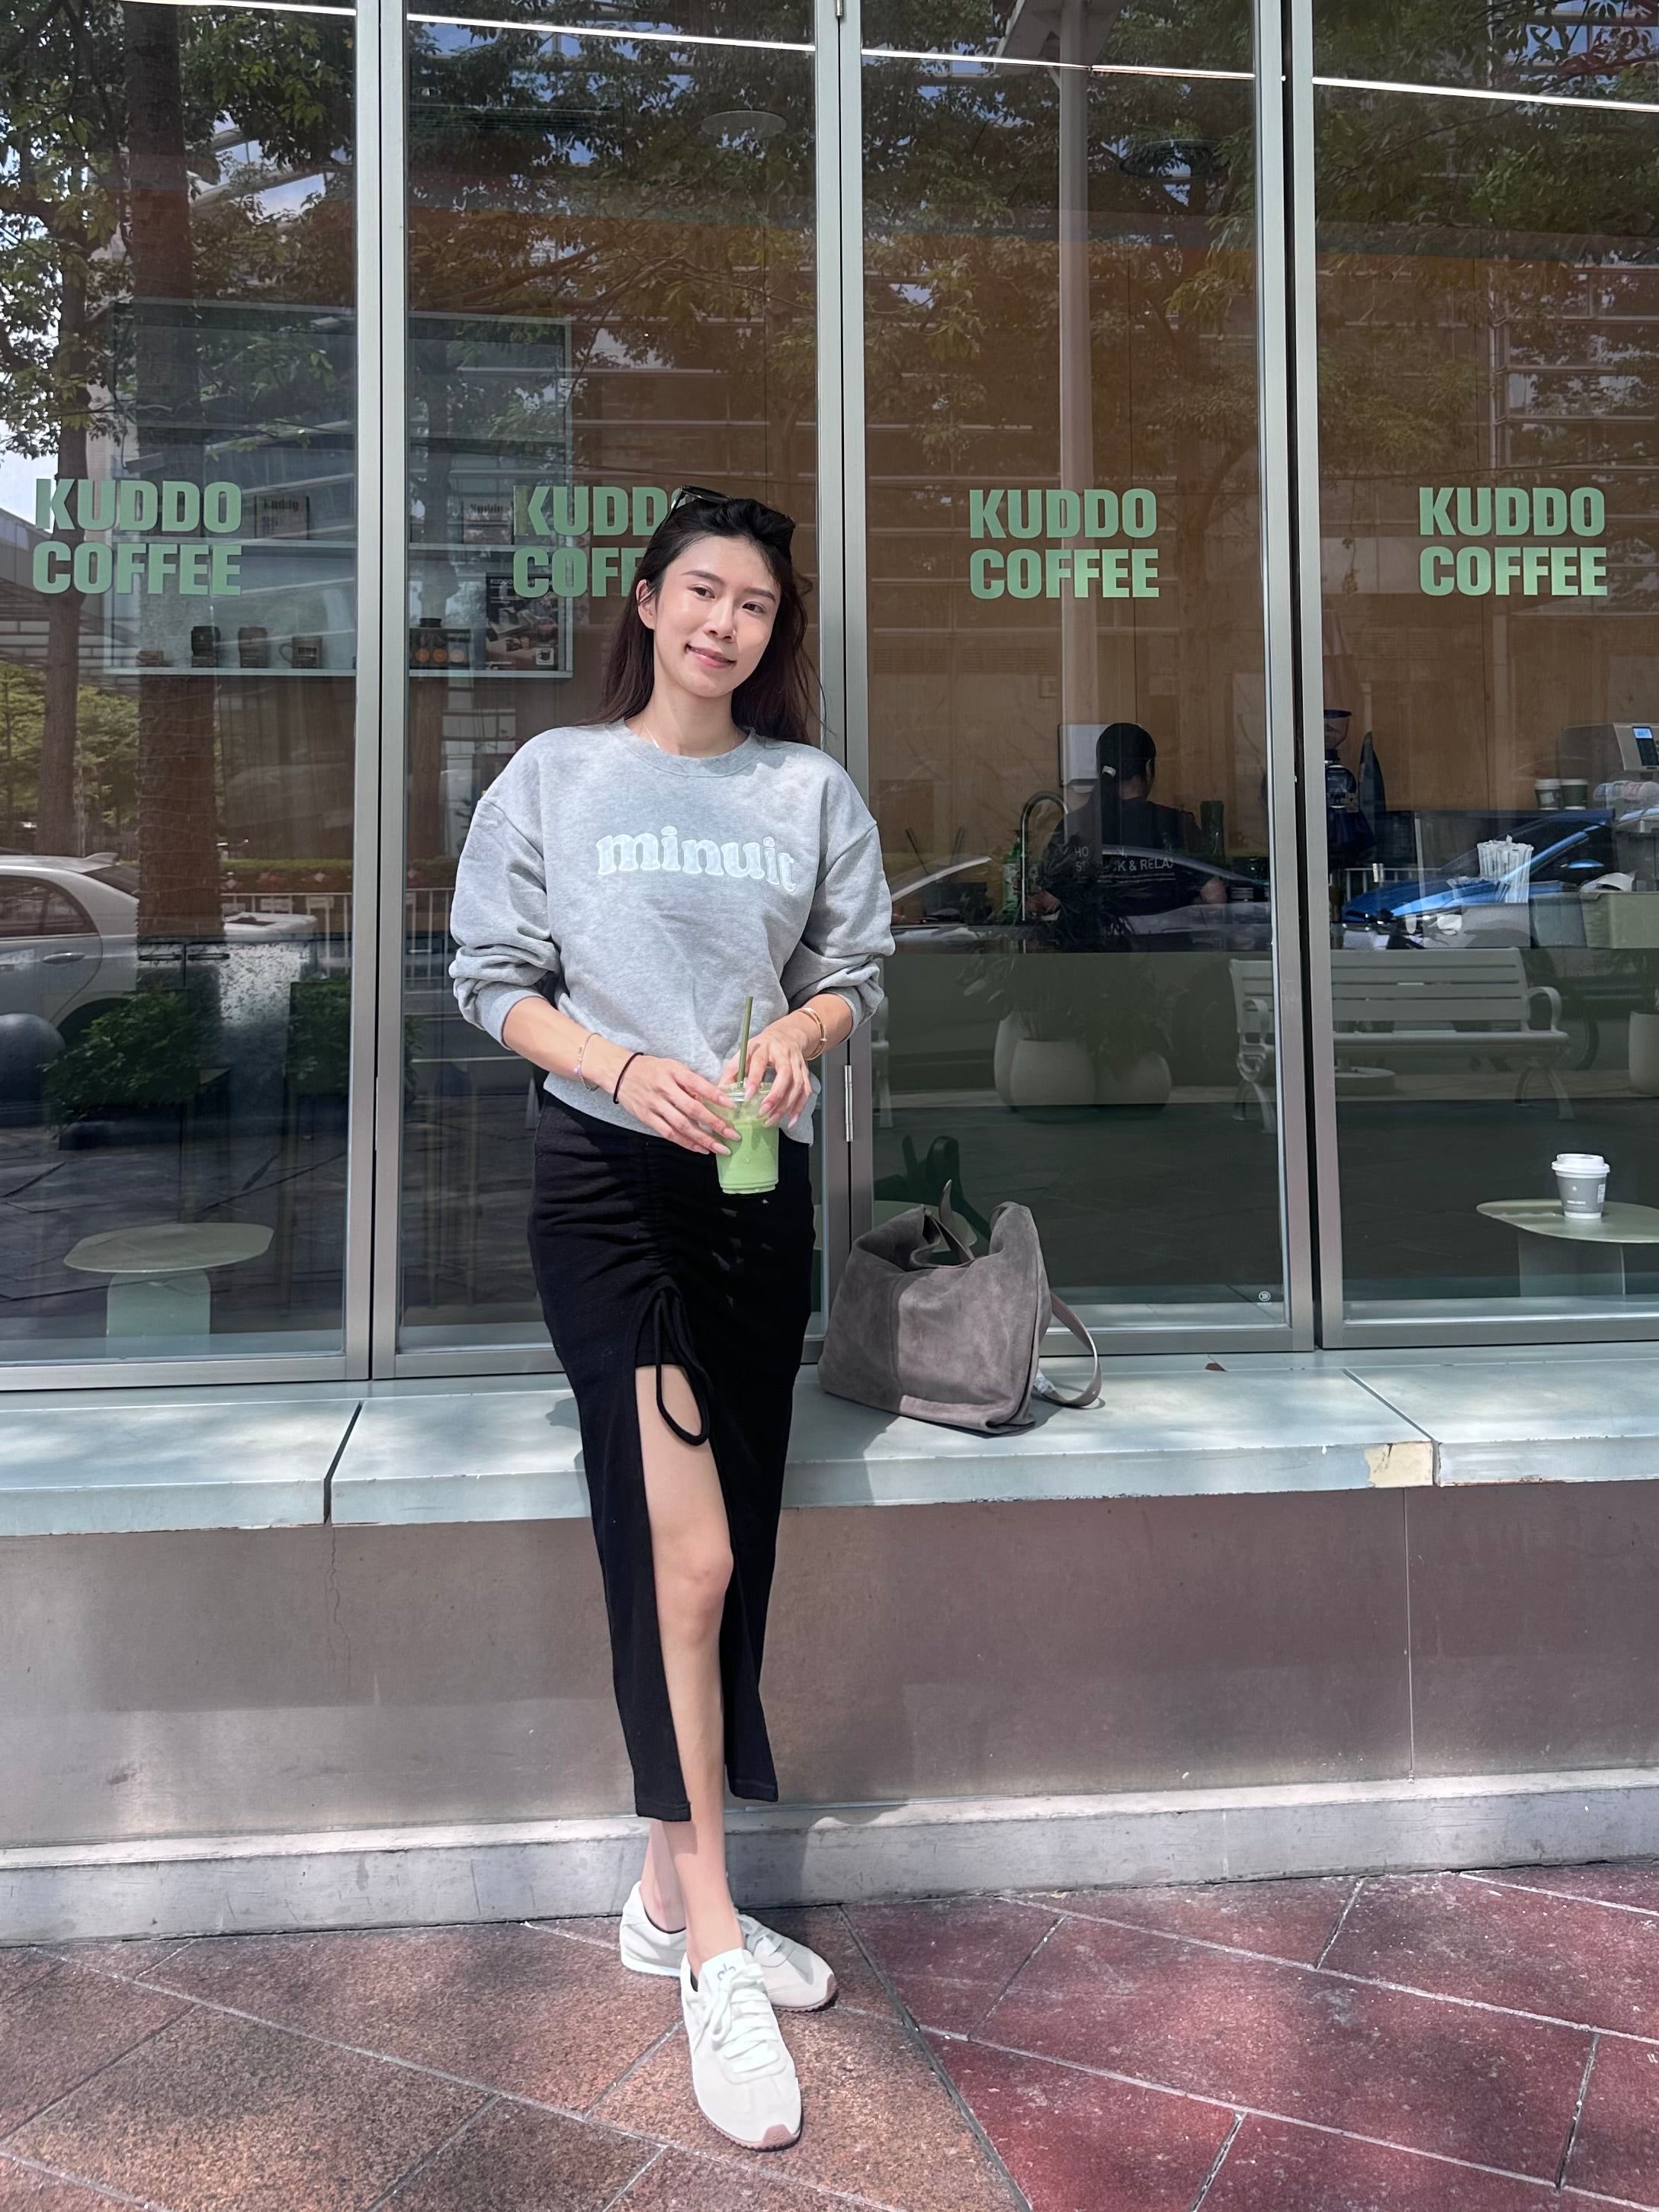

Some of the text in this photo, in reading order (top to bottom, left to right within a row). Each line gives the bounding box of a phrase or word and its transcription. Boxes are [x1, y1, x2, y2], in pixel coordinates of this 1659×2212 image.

[35, 478, 242, 533] KUDDO
[969, 488, 1157, 539] KUDDO
[1418, 486, 1606, 537] KUDDO
[32, 541, 242, 596] COFFEE
[512, 546, 647, 598] COFF
[969, 548, 1160, 600] COFFEE
[1419, 546, 1608, 596] COFFEE
[595, 825, 797, 893] minuit
[1129, 859, 1138, 871] &
